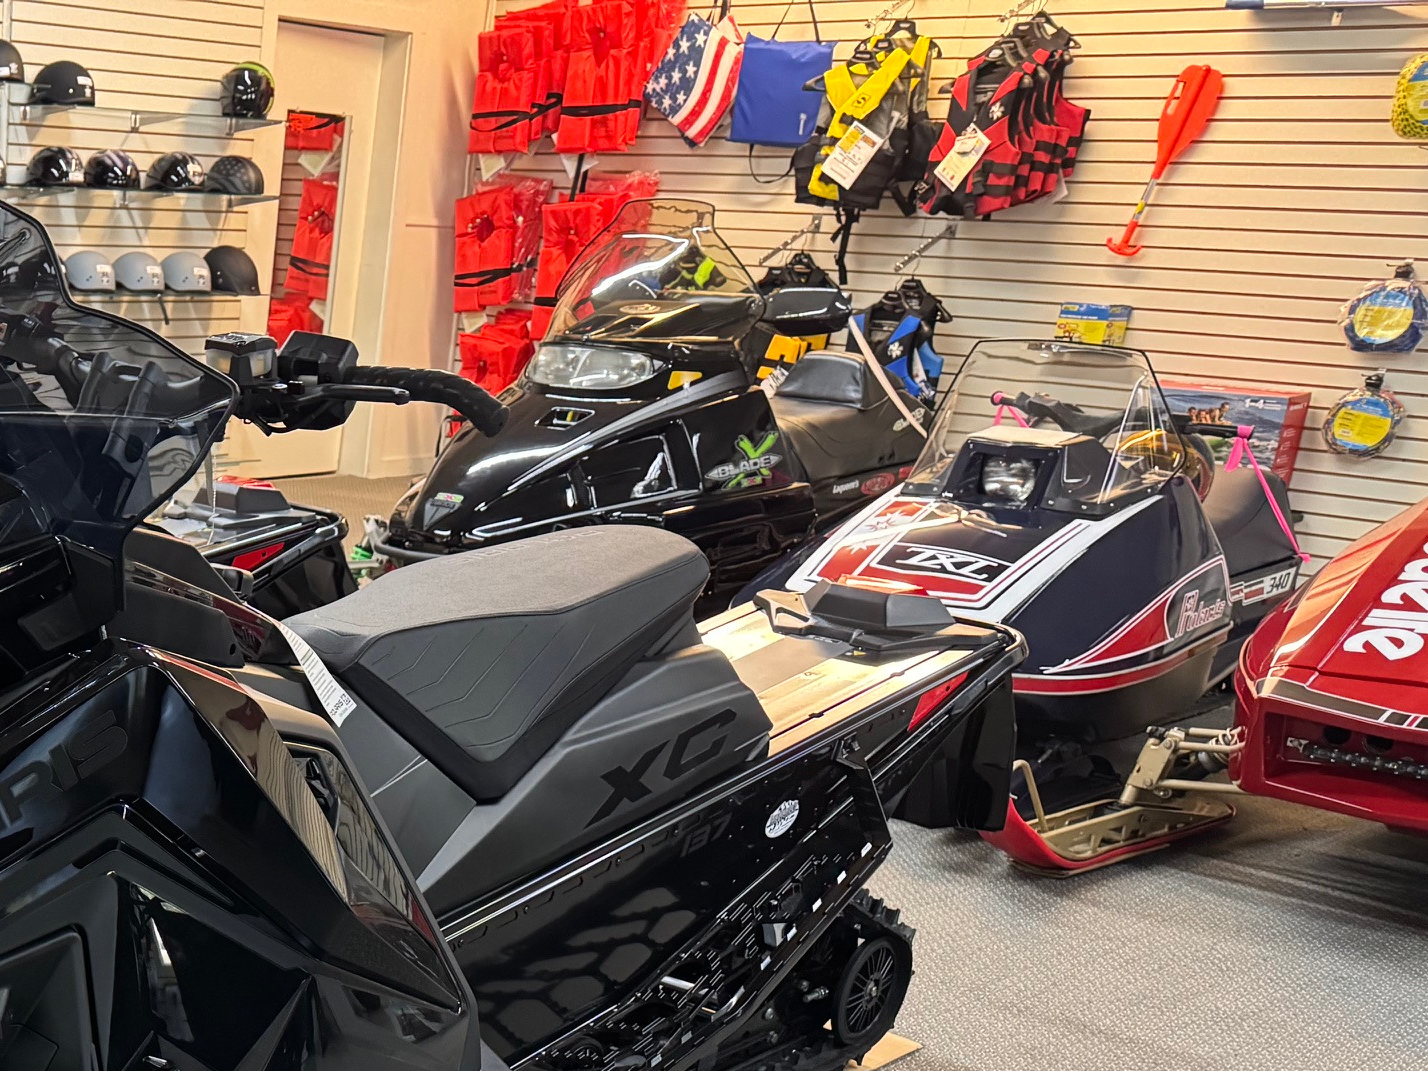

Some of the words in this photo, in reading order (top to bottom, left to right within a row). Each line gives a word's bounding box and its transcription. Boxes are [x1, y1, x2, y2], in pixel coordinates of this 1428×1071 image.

[715, 455, 773, 478] BLADE
[1265, 572, 1291, 595] 340
[583, 708, 737, 830] XC
